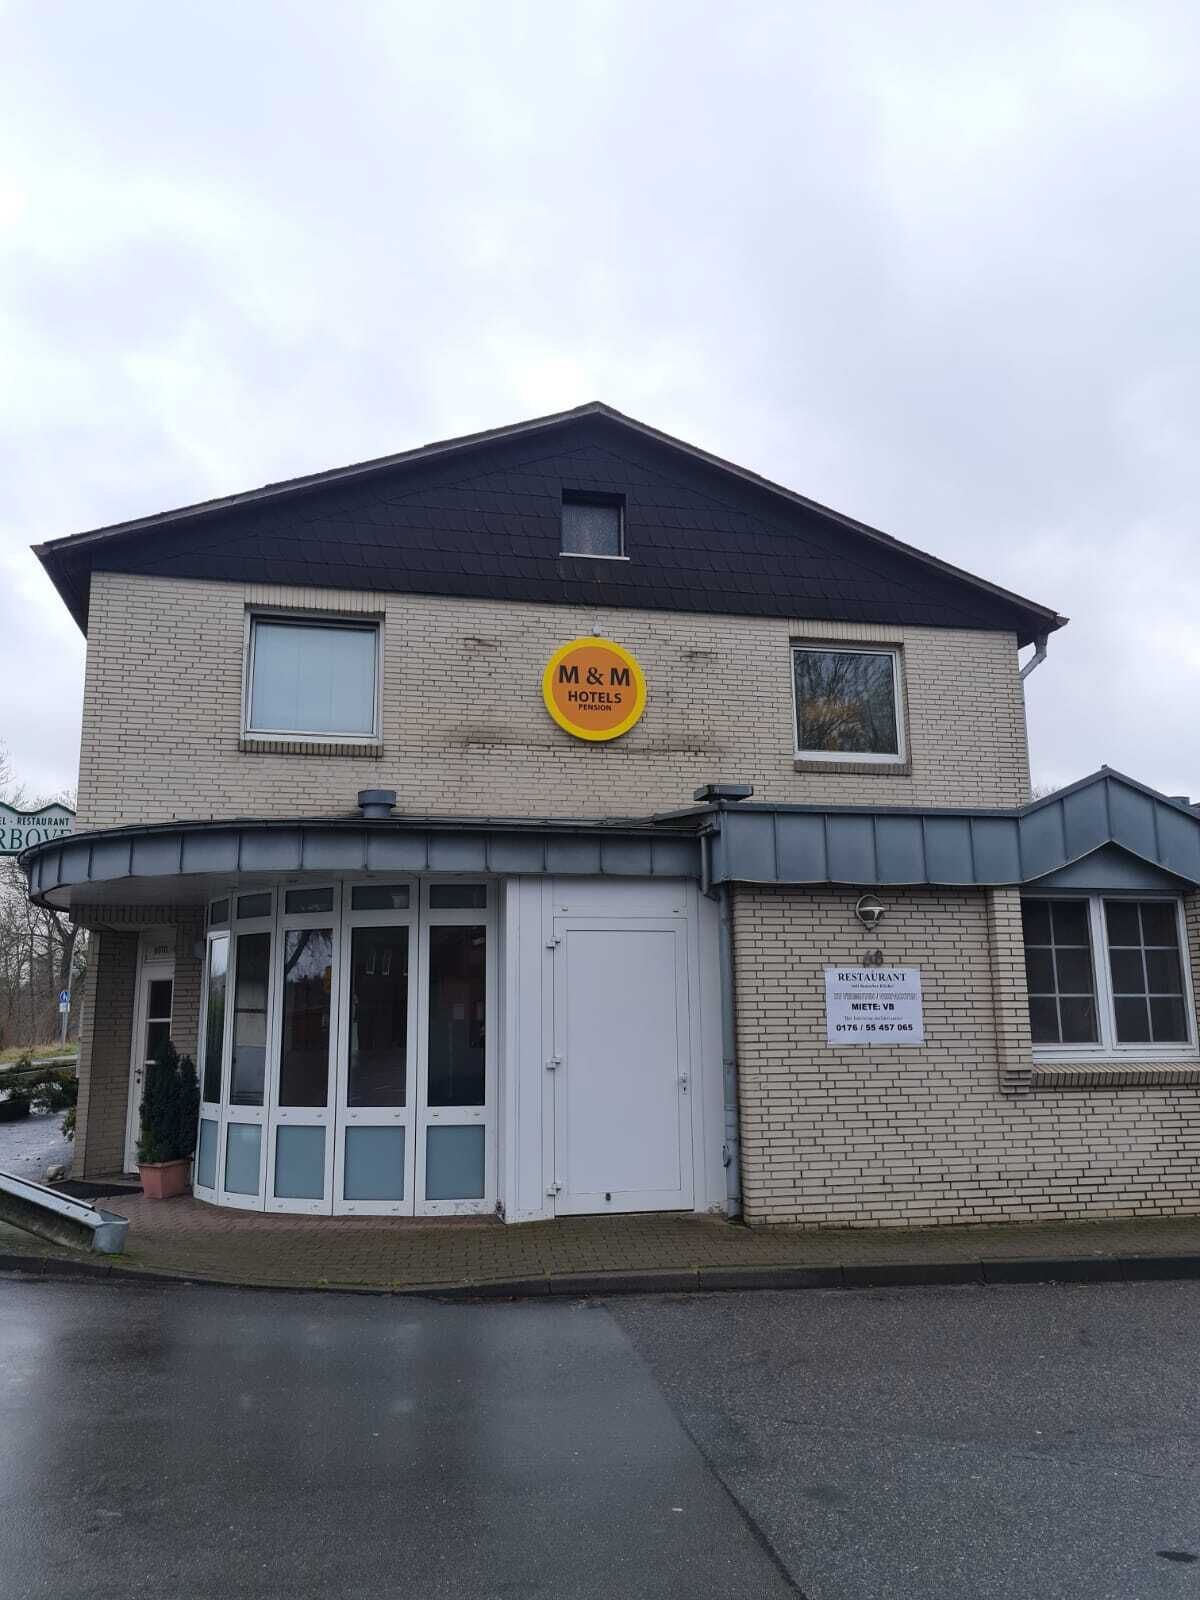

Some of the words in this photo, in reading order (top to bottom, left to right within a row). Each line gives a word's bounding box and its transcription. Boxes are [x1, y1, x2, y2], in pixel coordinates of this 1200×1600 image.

[559, 665, 579, 684] M
[586, 667, 604, 686] &
[610, 667, 630, 687] M
[568, 691, 622, 704] HOTELS
[578, 704, 612, 712] PENSION
[17, 817, 70, 826] RESTAURANT
[838, 973, 906, 982] RESTAURANT
[851, 1003, 881, 1011] MIETE:
[883, 1003, 895, 1011] VB
[836, 1024, 858, 1032] 0176
[897, 1023, 913, 1031] 065
